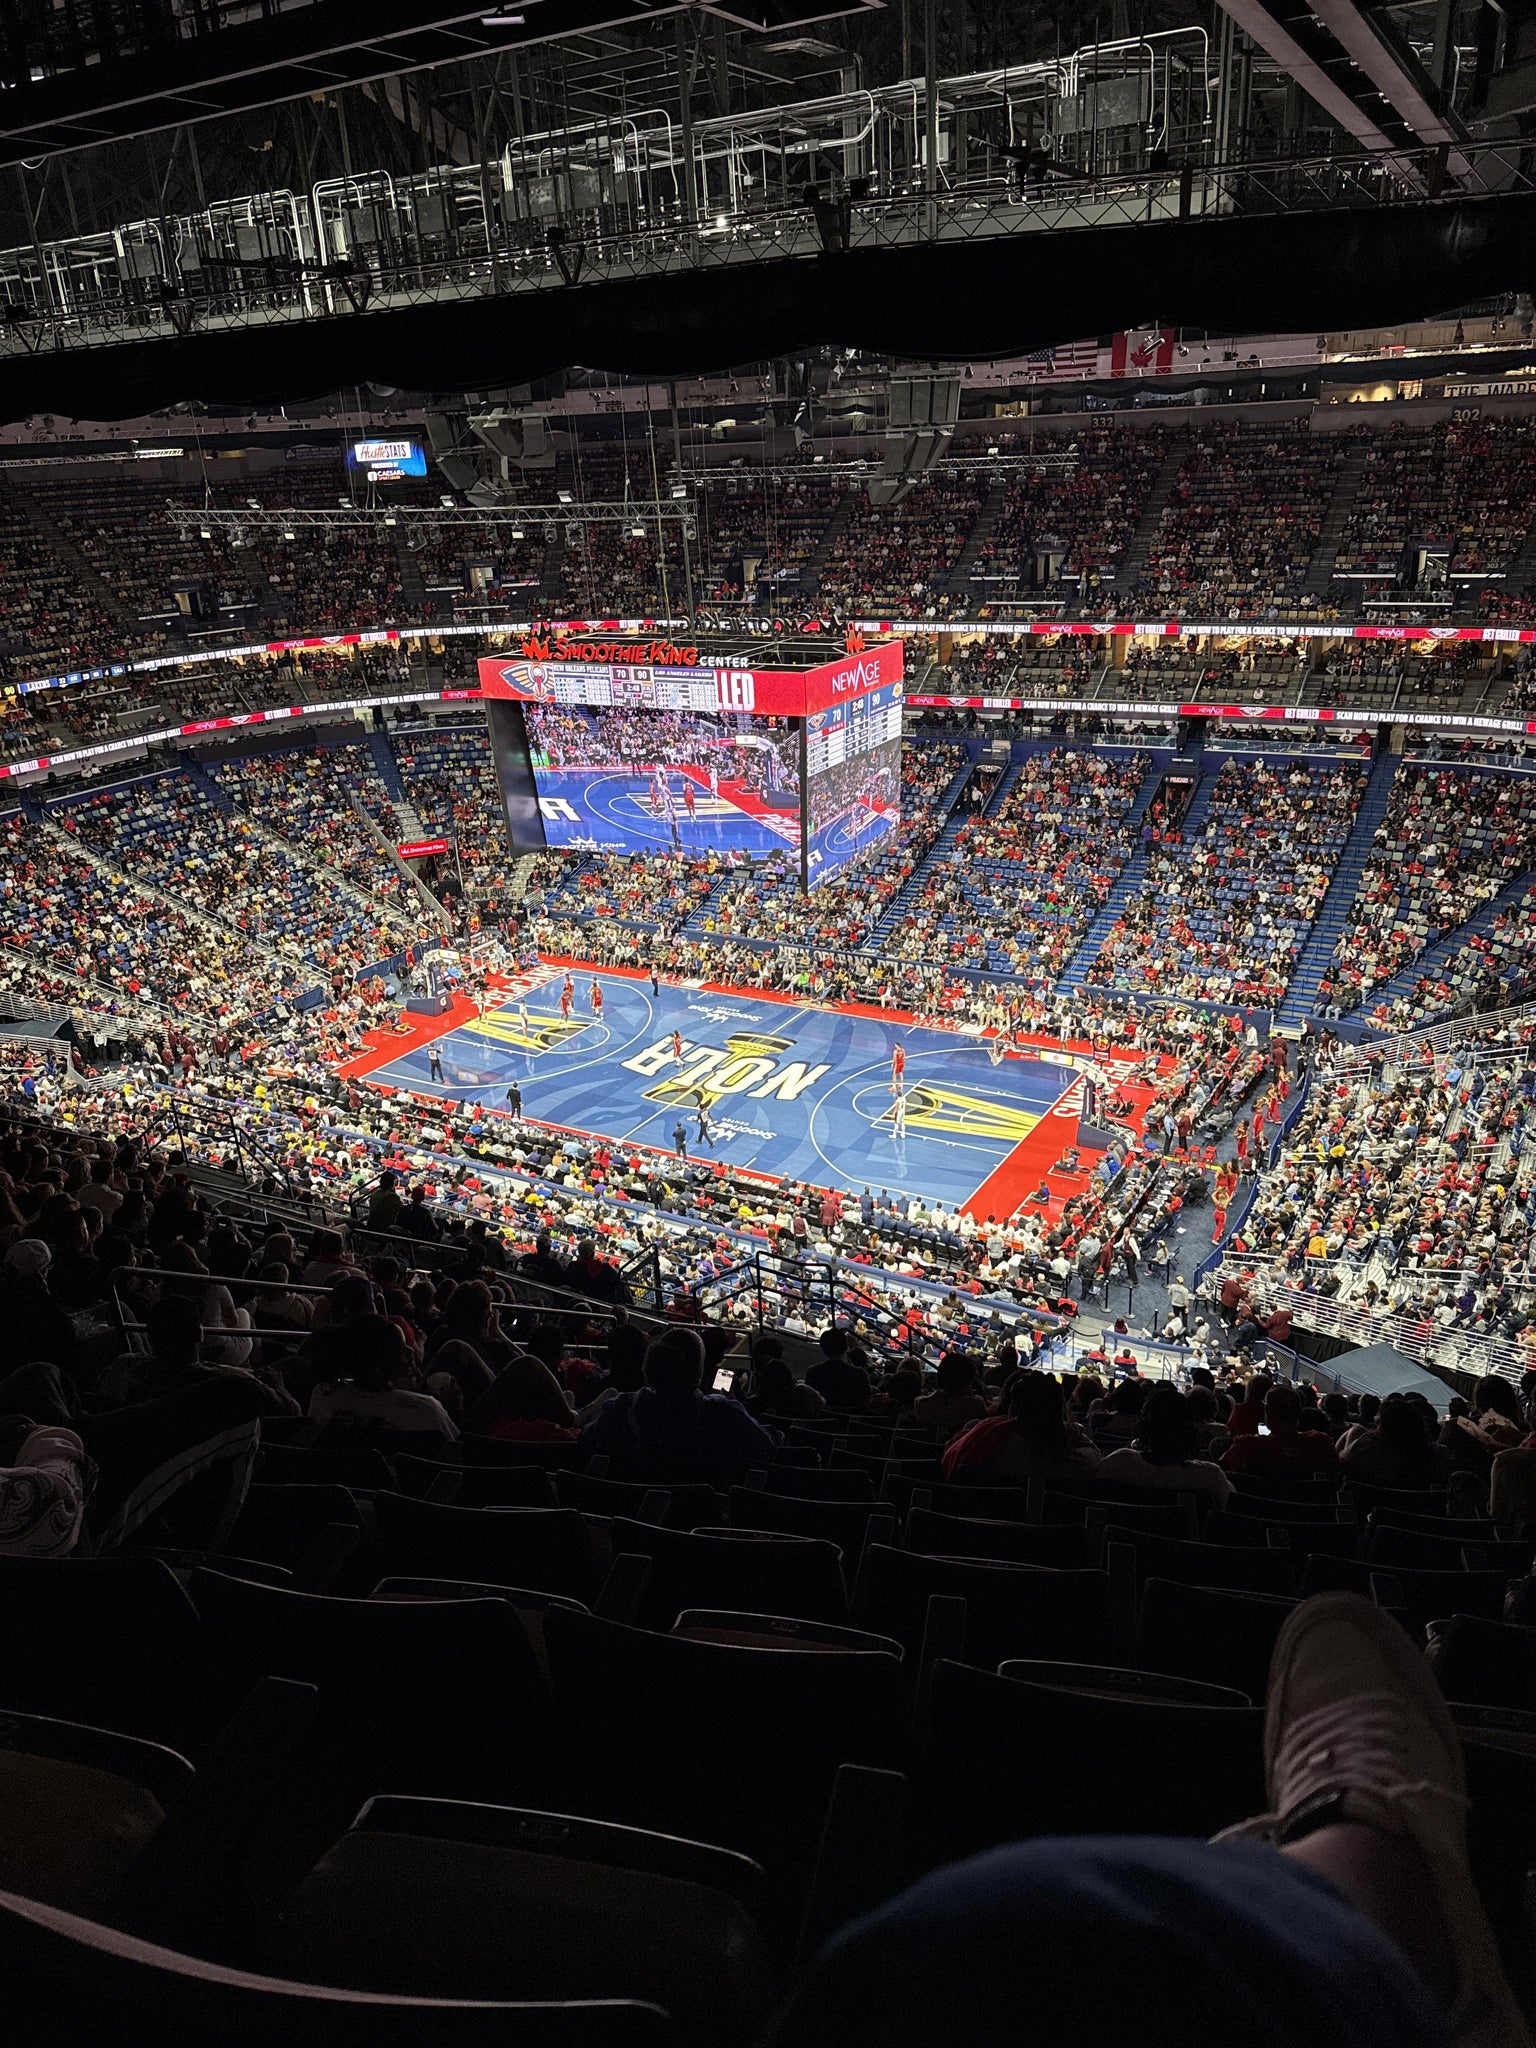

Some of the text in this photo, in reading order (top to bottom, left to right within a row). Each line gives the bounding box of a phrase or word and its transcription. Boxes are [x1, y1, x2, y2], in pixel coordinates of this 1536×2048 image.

[1453, 409, 1480, 421] 302
[1092, 417, 1114, 428] 332
[1212, 625, 1220, 635] TO
[1220, 626, 1234, 635] PLAY
[1235, 626, 1246, 635] FOR
[1253, 626, 1276, 636] CHANCE
[1277, 626, 1285, 636] TO
[1377, 628, 1405, 637] NEWAGE
[555, 637, 648, 664] SMOOTHIE
[700, 656, 750, 668] CENTER
[586, 666, 610, 675] PELICANS
[616, 670, 627, 679] 70
[637, 671, 647, 680] 90
[832, 660, 880, 694] NEWAGE
[4, 686, 15, 695] 90
[1051, 701, 1058, 710] TO
[1058, 701, 1071, 710] PLAY
[1071, 702, 1082, 710] FOR
[1087, 702, 1109, 711] CHANCE
[1109, 703, 1116, 711] TO
[832, 709, 842, 723] 70
[1336, 711, 1353, 720] SCAN
[1353, 711, 1369, 721] NOW
[1369, 712, 1378, 722] TO
[1379, 712, 1395, 722] PLAY
[1395, 713, 1408, 723] FOR
[1415, 714, 1441, 725] CHANCE
[1442, 715, 1451, 725] TO
[620, 1033, 834, 1101] NOLA
[716, 1121, 777, 1140] SMOOTHIE
